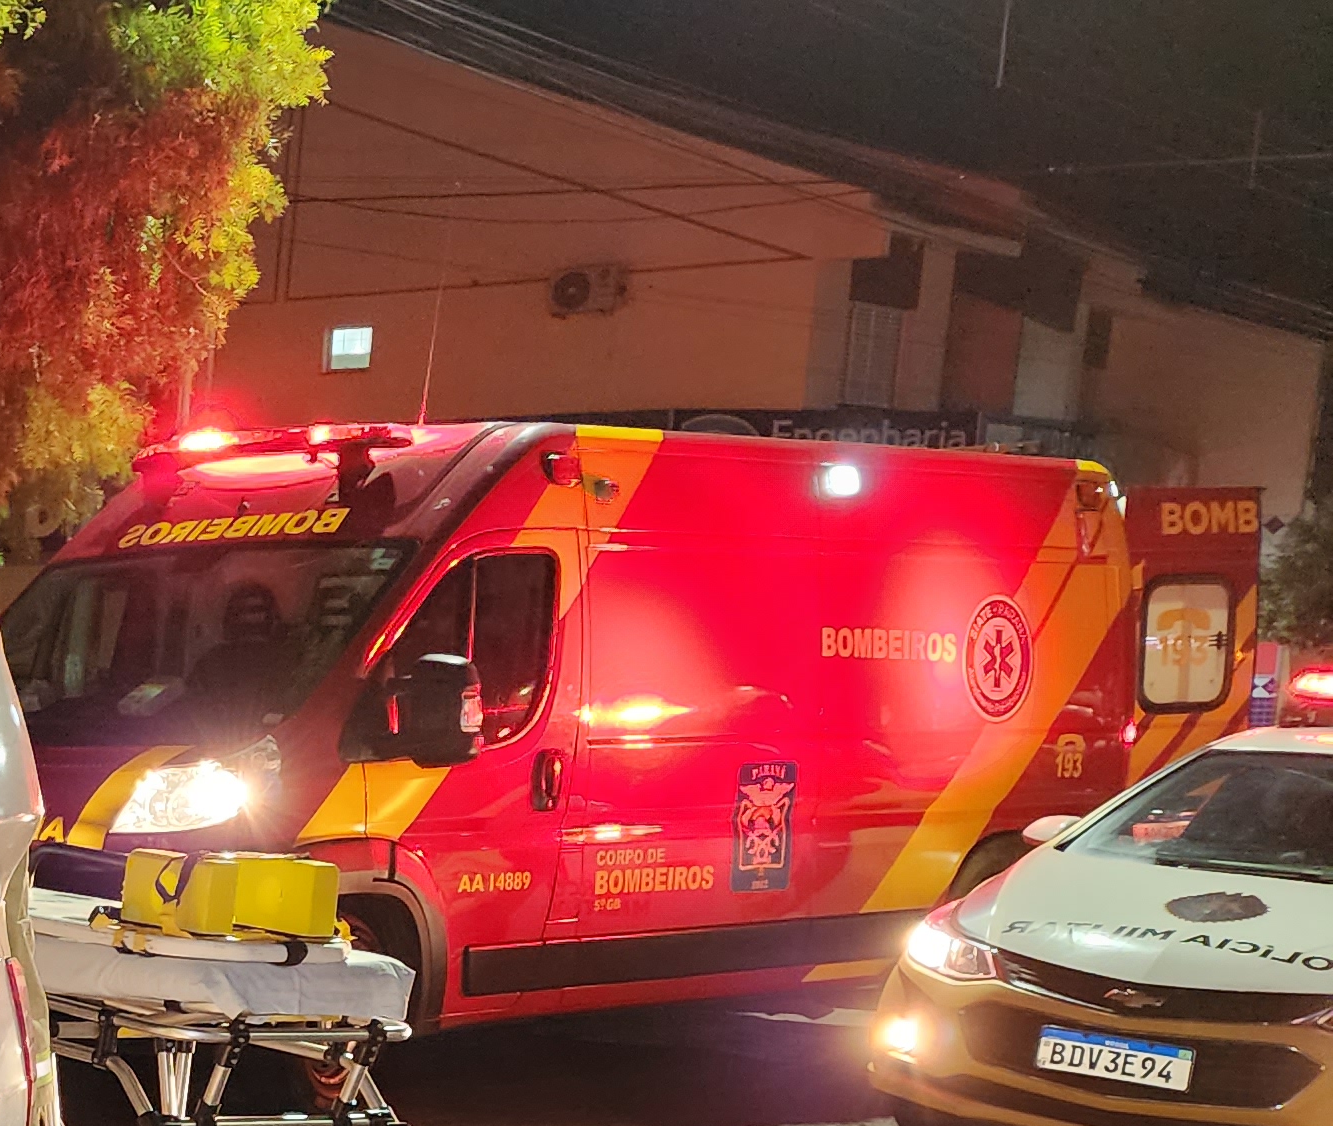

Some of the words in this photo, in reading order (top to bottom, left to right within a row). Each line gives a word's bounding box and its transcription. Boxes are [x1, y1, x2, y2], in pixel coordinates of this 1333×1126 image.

[1161, 500, 1259, 535] BOMB
[821, 626, 957, 664] BOMBEIROS
[1055, 751, 1083, 778] 193
[596, 849, 643, 867] CORPO
[647, 848, 666, 864] DE
[457, 873, 485, 893] AA
[594, 865, 715, 896] BOMBEIROS
[1048, 1041, 1174, 1085] BDV3E94
